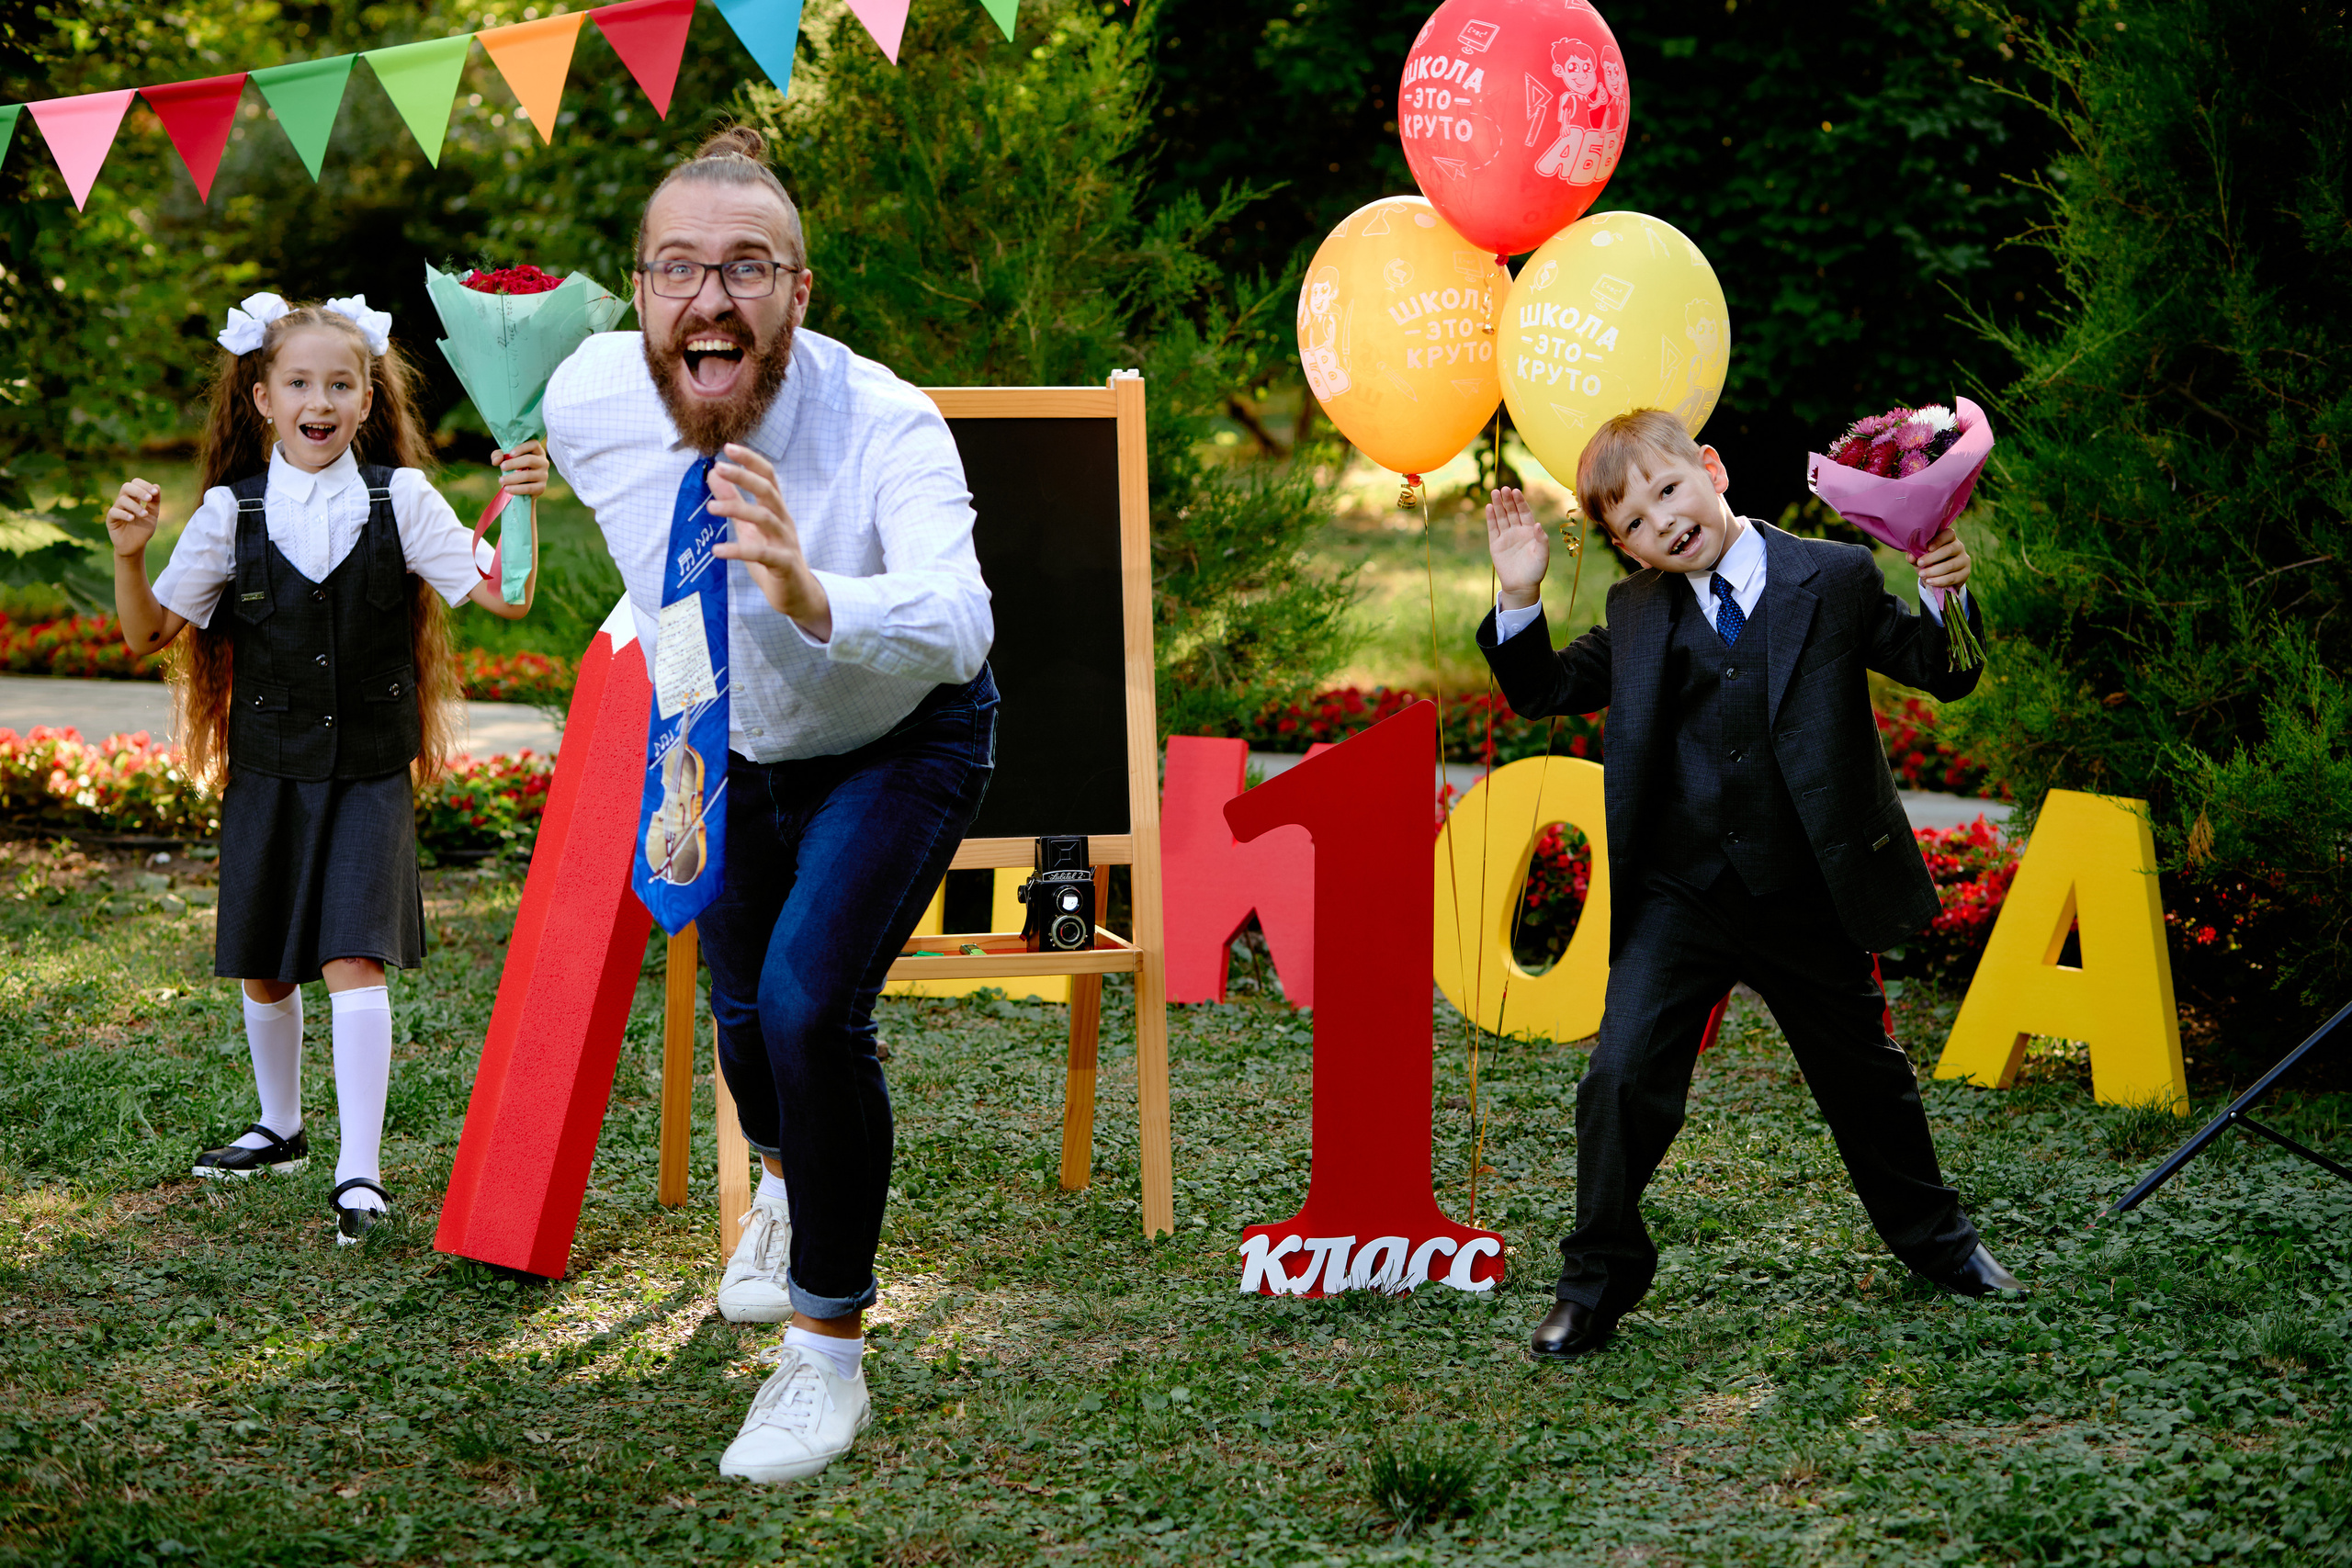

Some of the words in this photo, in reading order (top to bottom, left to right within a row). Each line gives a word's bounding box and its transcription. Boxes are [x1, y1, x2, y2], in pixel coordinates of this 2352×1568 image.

[1404, 55, 1485, 94] ШКОЛА
[1404, 114, 1473, 142] КРУТО
[1534, 125, 1622, 186] АБВ
[1520, 302, 1619, 352] ШКОЛА
[1407, 341, 1493, 369] КРУТО
[1517, 355, 1601, 397] КРУТО
